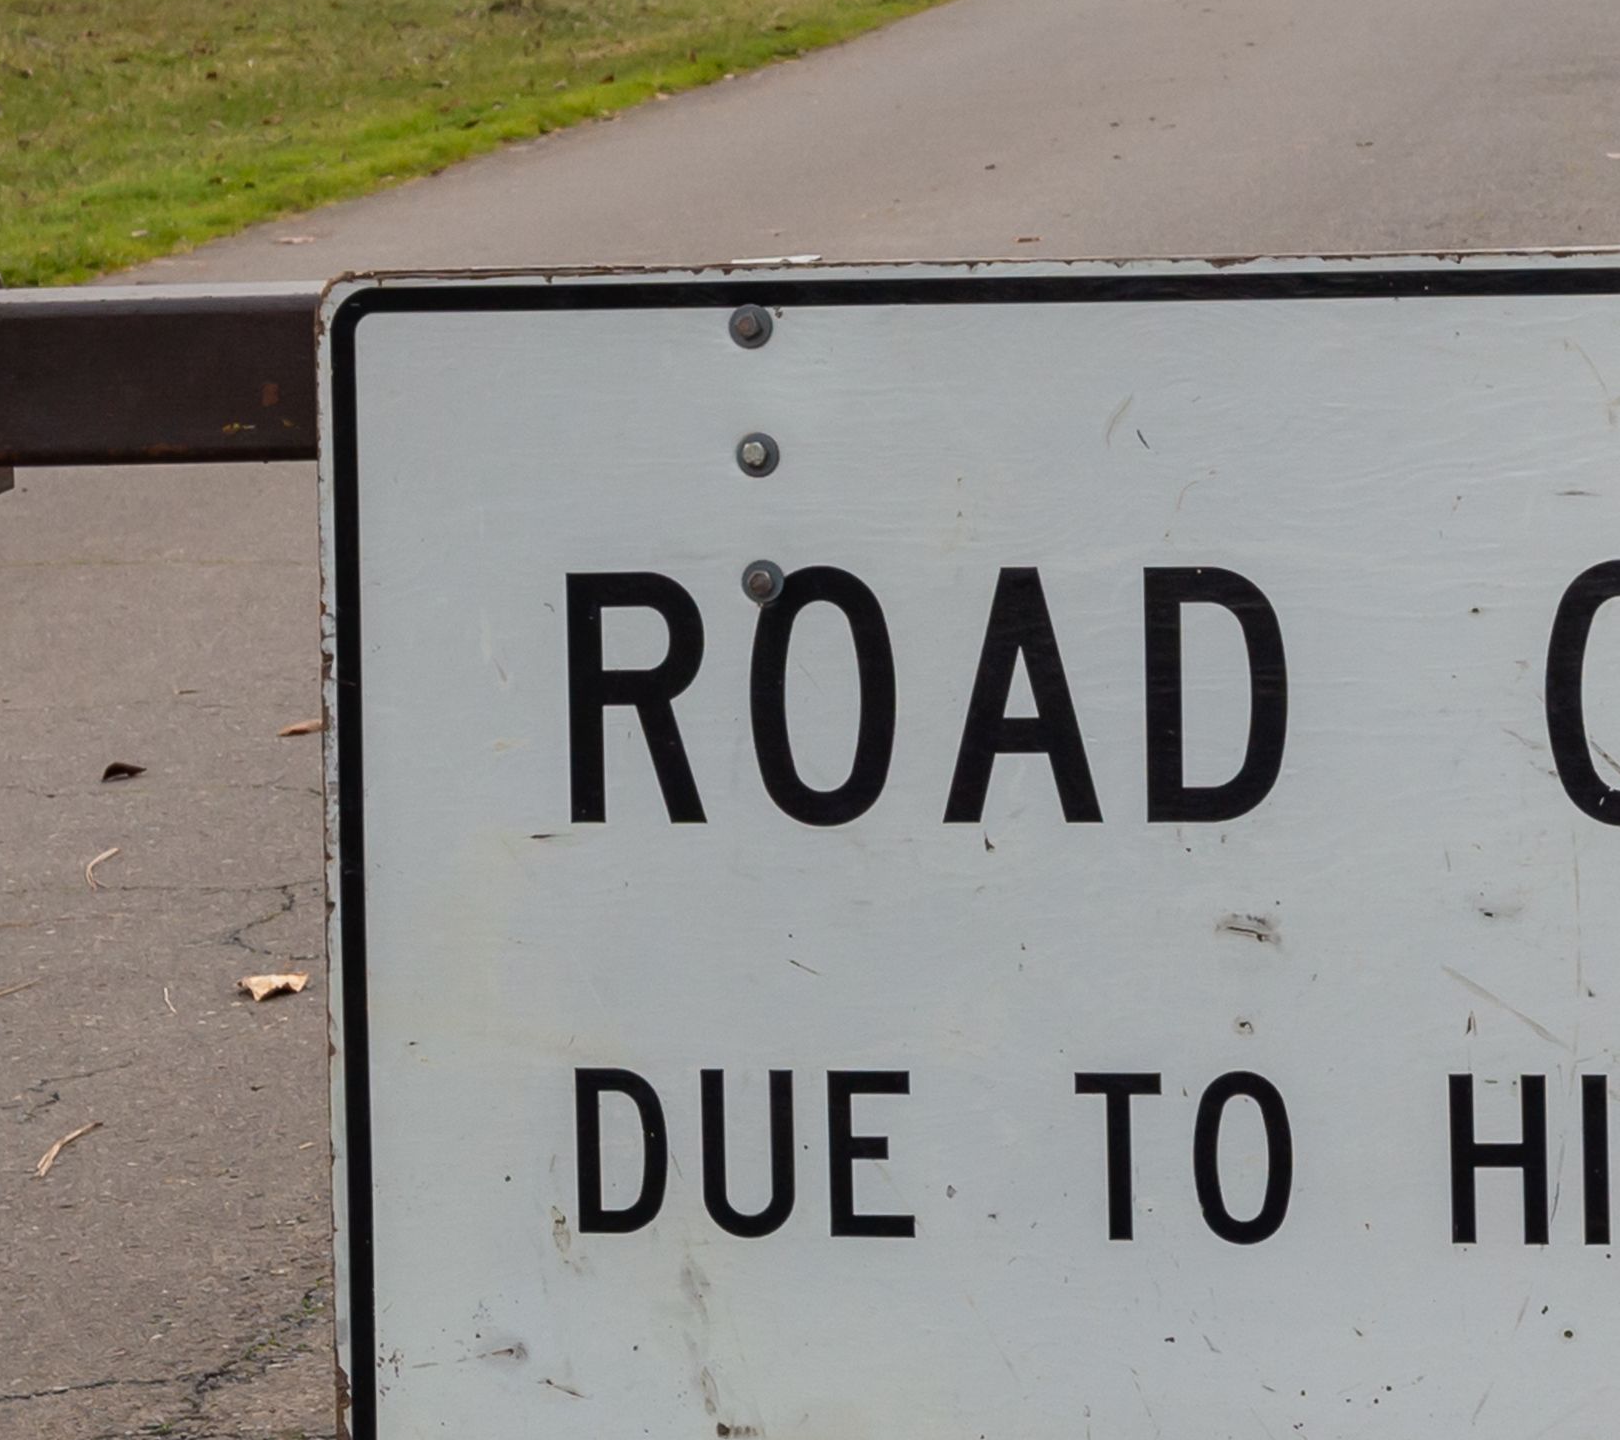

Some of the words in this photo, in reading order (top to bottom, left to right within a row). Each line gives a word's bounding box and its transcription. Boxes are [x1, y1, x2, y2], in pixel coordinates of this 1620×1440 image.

[564, 564, 1289, 827] ROAD
[573, 1067, 917, 1239] DUE
[1073, 1070, 1294, 1246] TO
